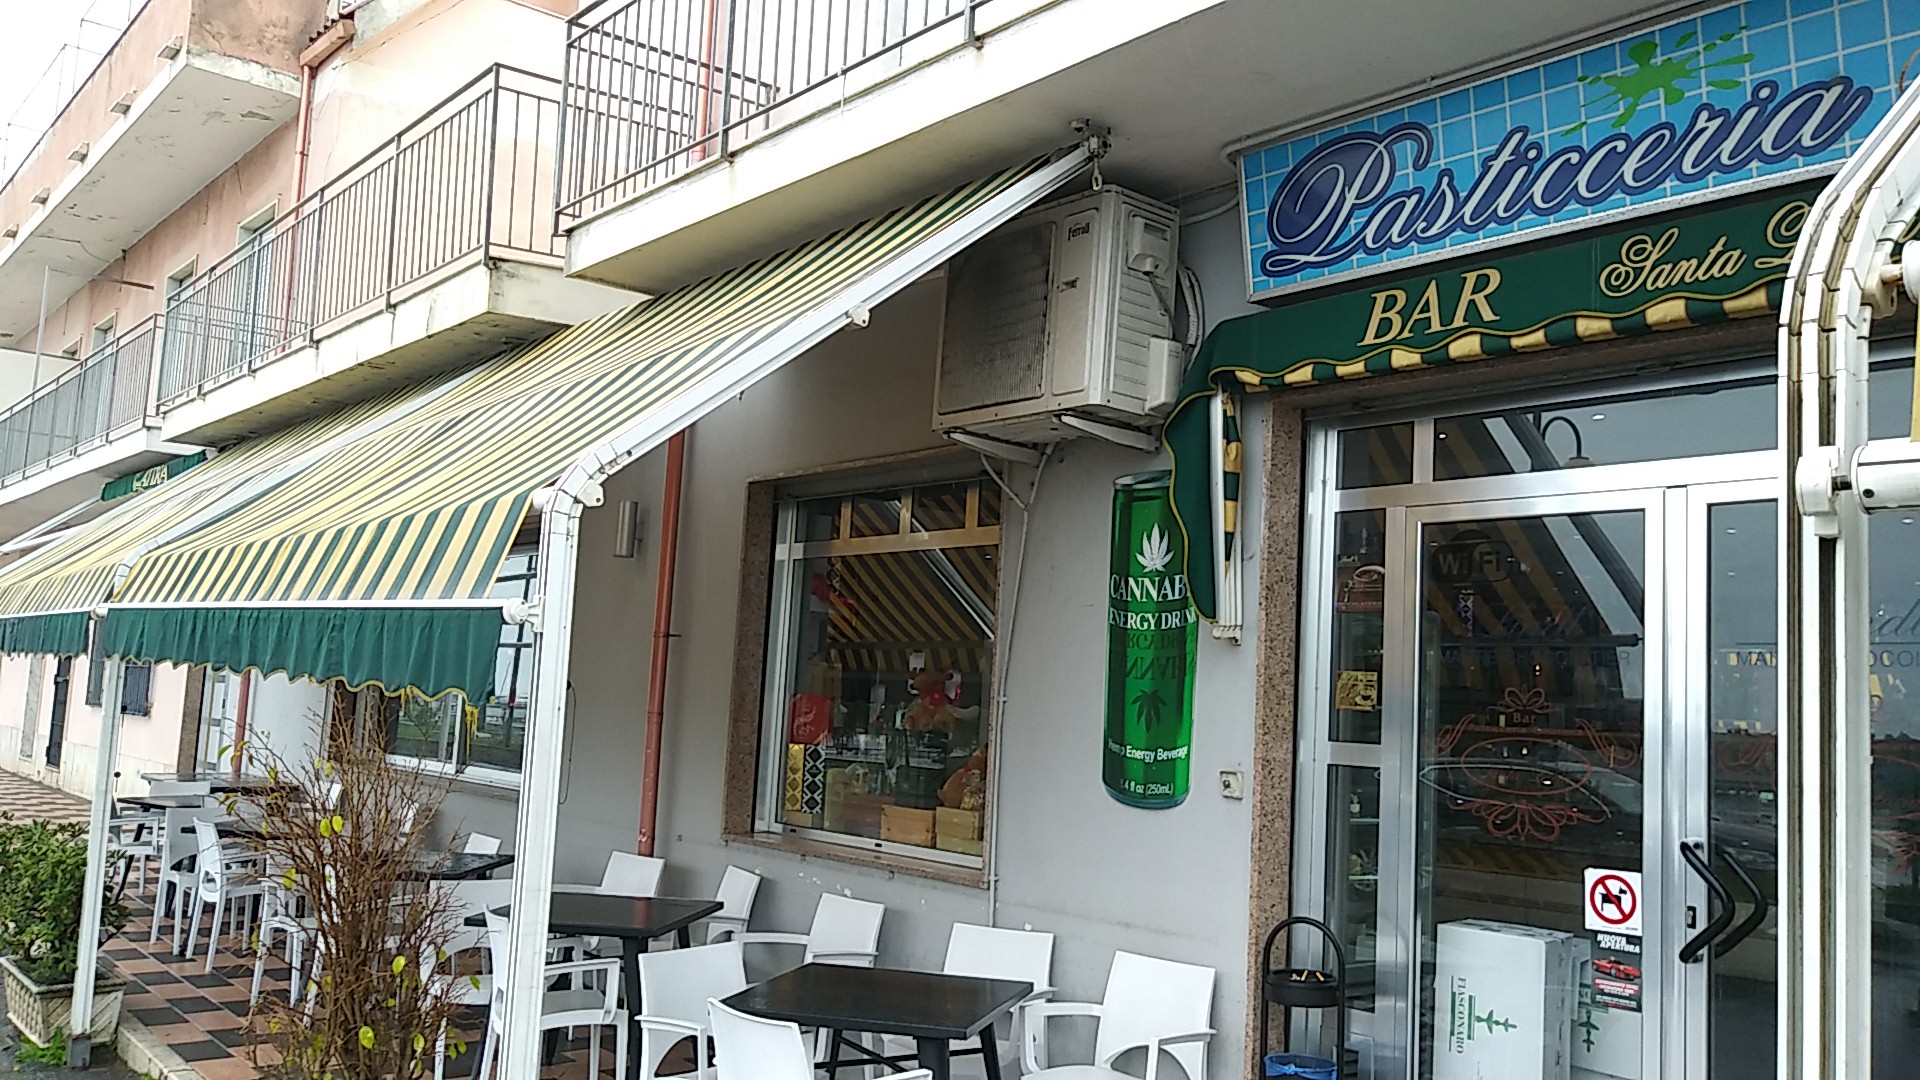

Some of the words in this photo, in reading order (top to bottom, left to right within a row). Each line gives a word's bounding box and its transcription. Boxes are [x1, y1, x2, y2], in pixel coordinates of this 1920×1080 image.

[1262, 77, 1867, 271] Pasticceria
[1357, 267, 1503, 347] BAR
[1600, 228, 1747, 297] Santa
[1110, 574, 1190, 602] CANNAB
[1109, 607, 1158, 631] ENERGY
[1126, 745, 1156, 763] Energy
[1136, 784, 1146, 794] oz
[1145, 783, 1175, 797] (250mL)
